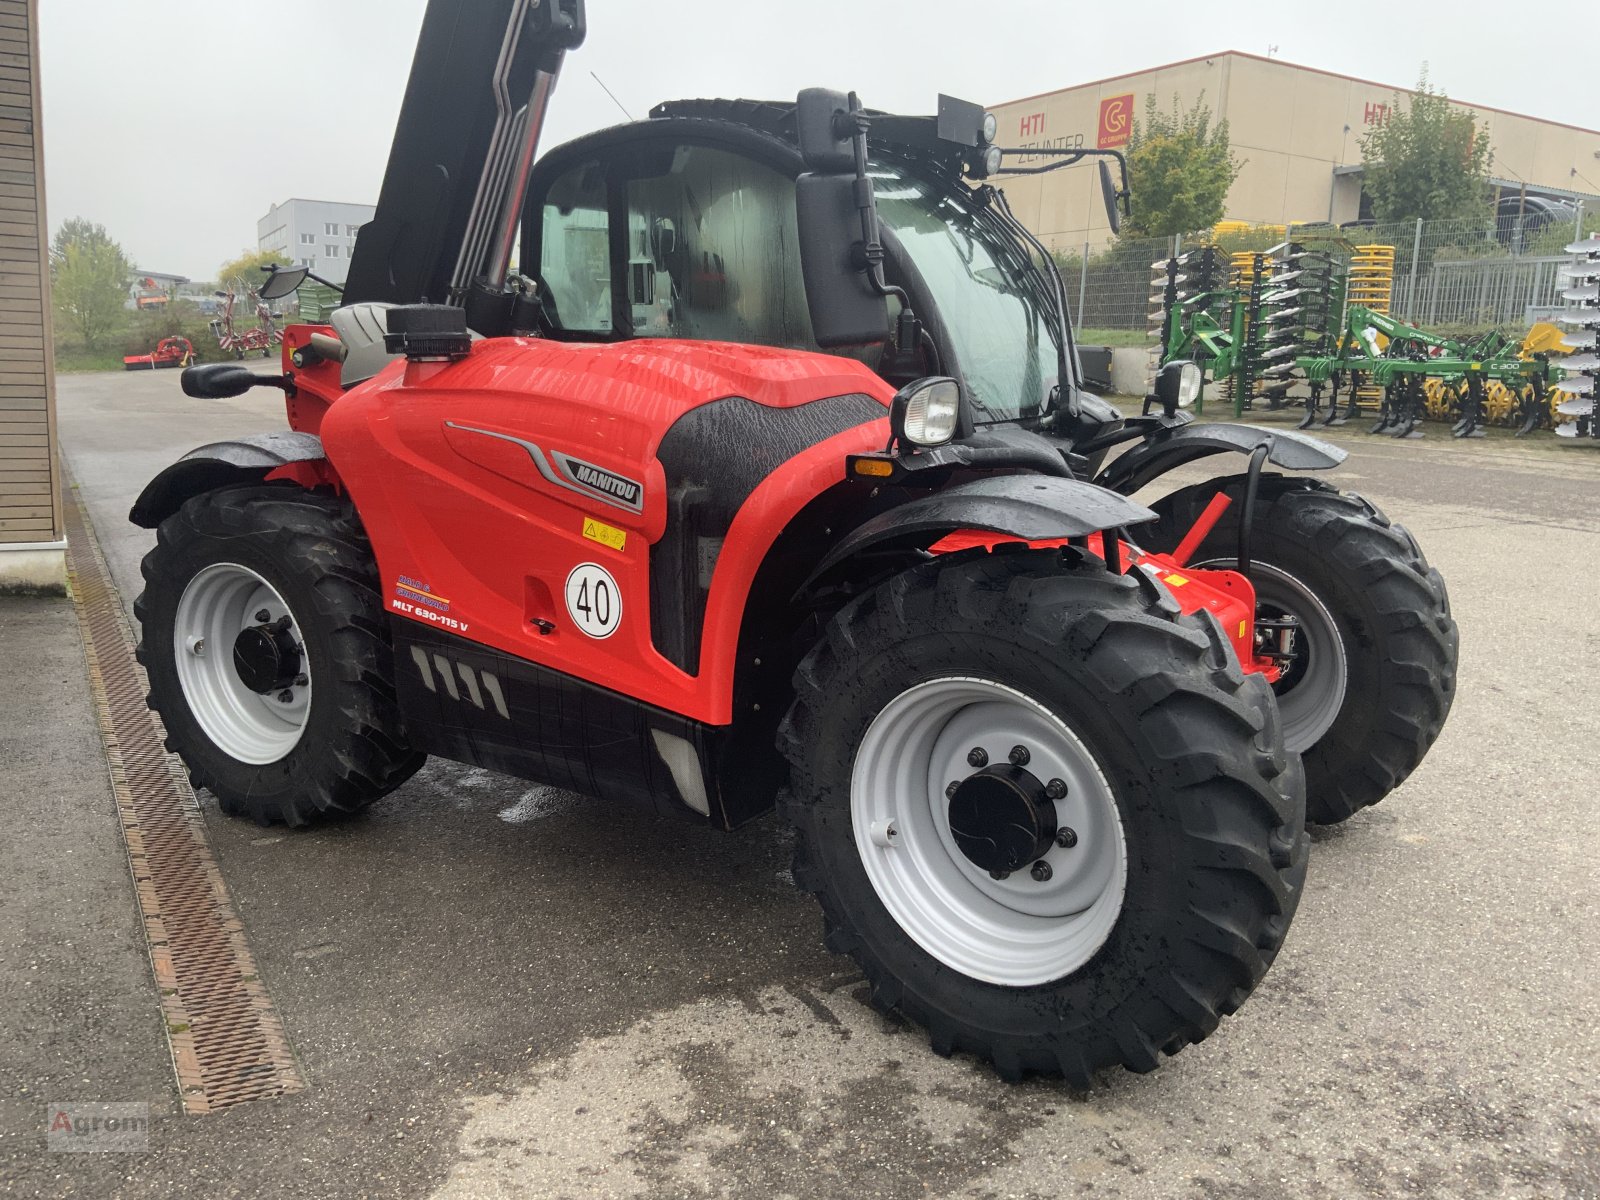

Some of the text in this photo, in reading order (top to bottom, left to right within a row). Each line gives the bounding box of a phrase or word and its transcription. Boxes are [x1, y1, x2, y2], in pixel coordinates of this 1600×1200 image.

[1020, 113, 1045, 137] HTI
[1364, 102, 1391, 128] HTI
[1018, 133, 1084, 164] ZEHNTER
[577, 465, 636, 500] MANITOU
[393, 599, 469, 632] MLT 630-115 V
[577, 577, 609, 625] 40
